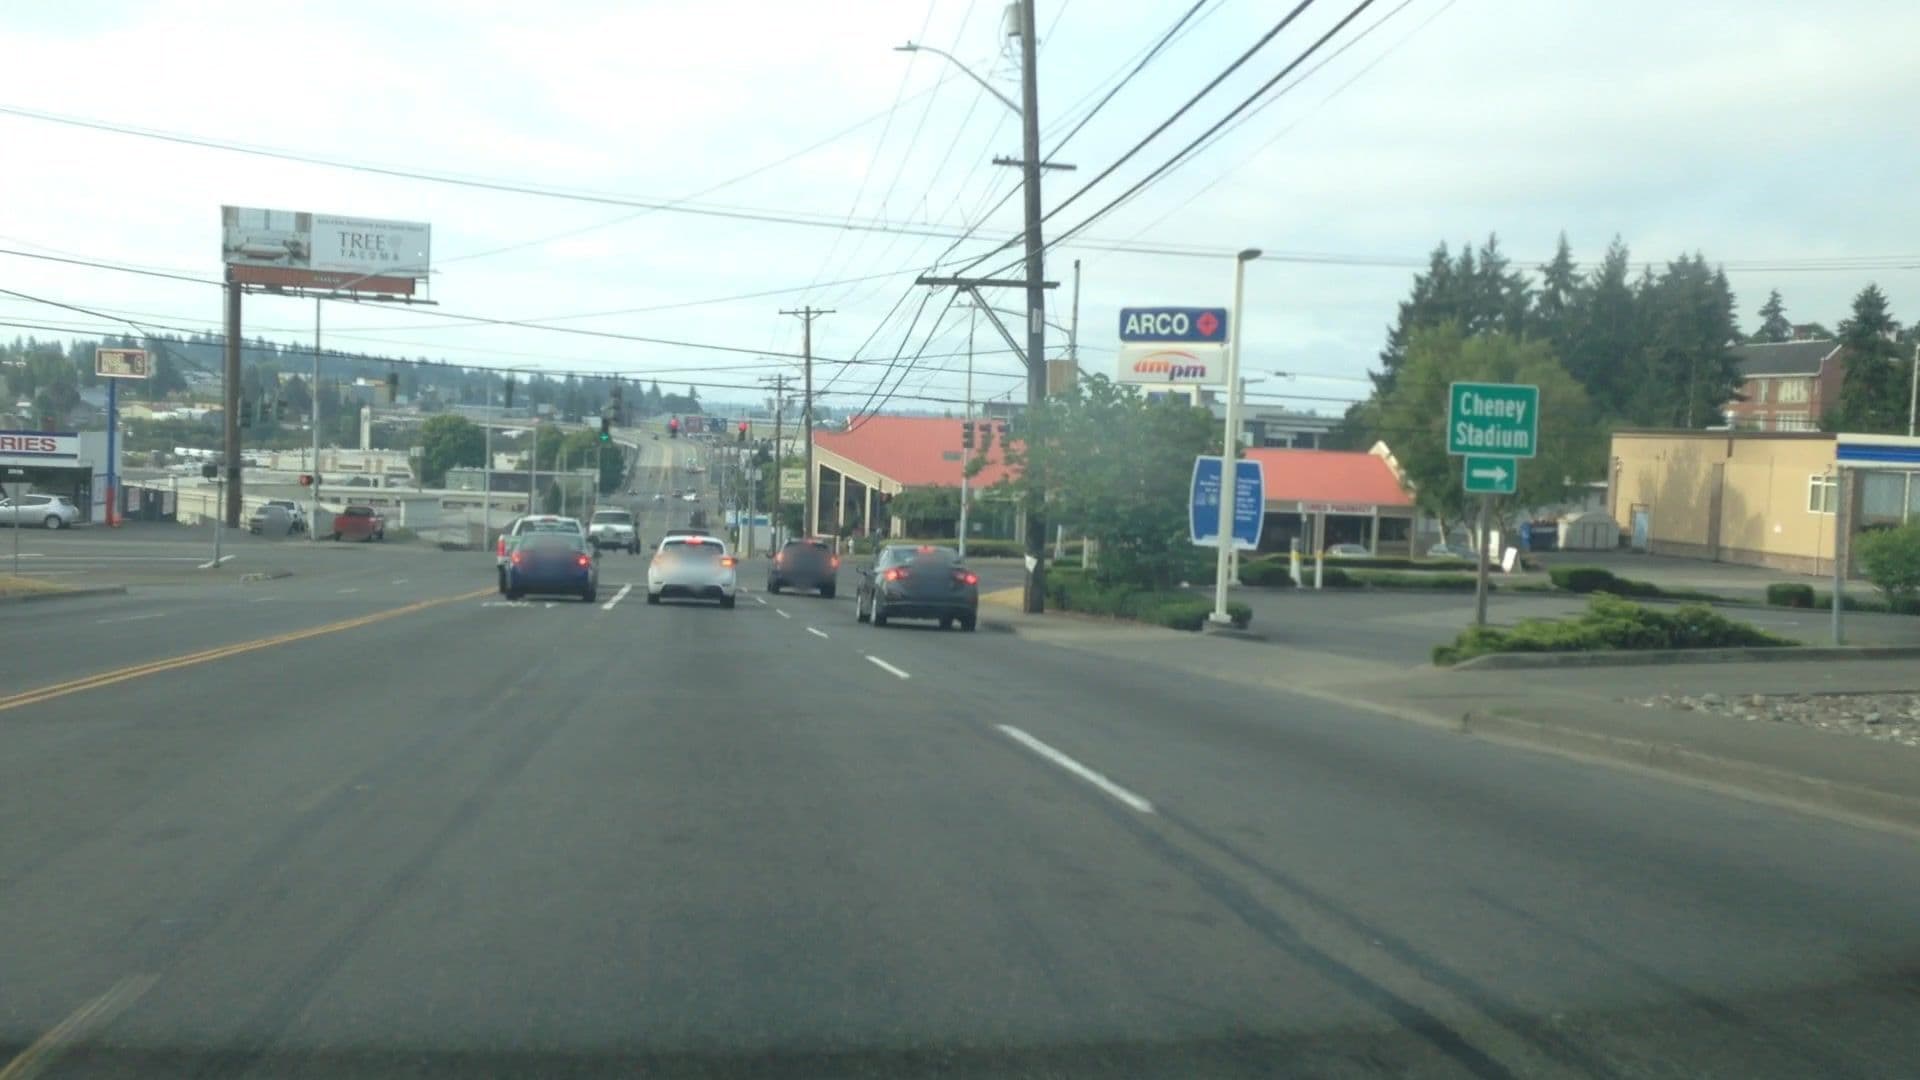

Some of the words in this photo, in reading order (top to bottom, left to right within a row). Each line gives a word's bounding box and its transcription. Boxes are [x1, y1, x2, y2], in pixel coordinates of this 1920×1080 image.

[338, 230, 386, 251] TREE
[340, 250, 399, 261] TACOMA
[1125, 313, 1189, 335] ARCO
[1461, 391, 1526, 424] Cheney
[0, 436, 57, 451] RIES
[1456, 421, 1529, 449] Stadium
